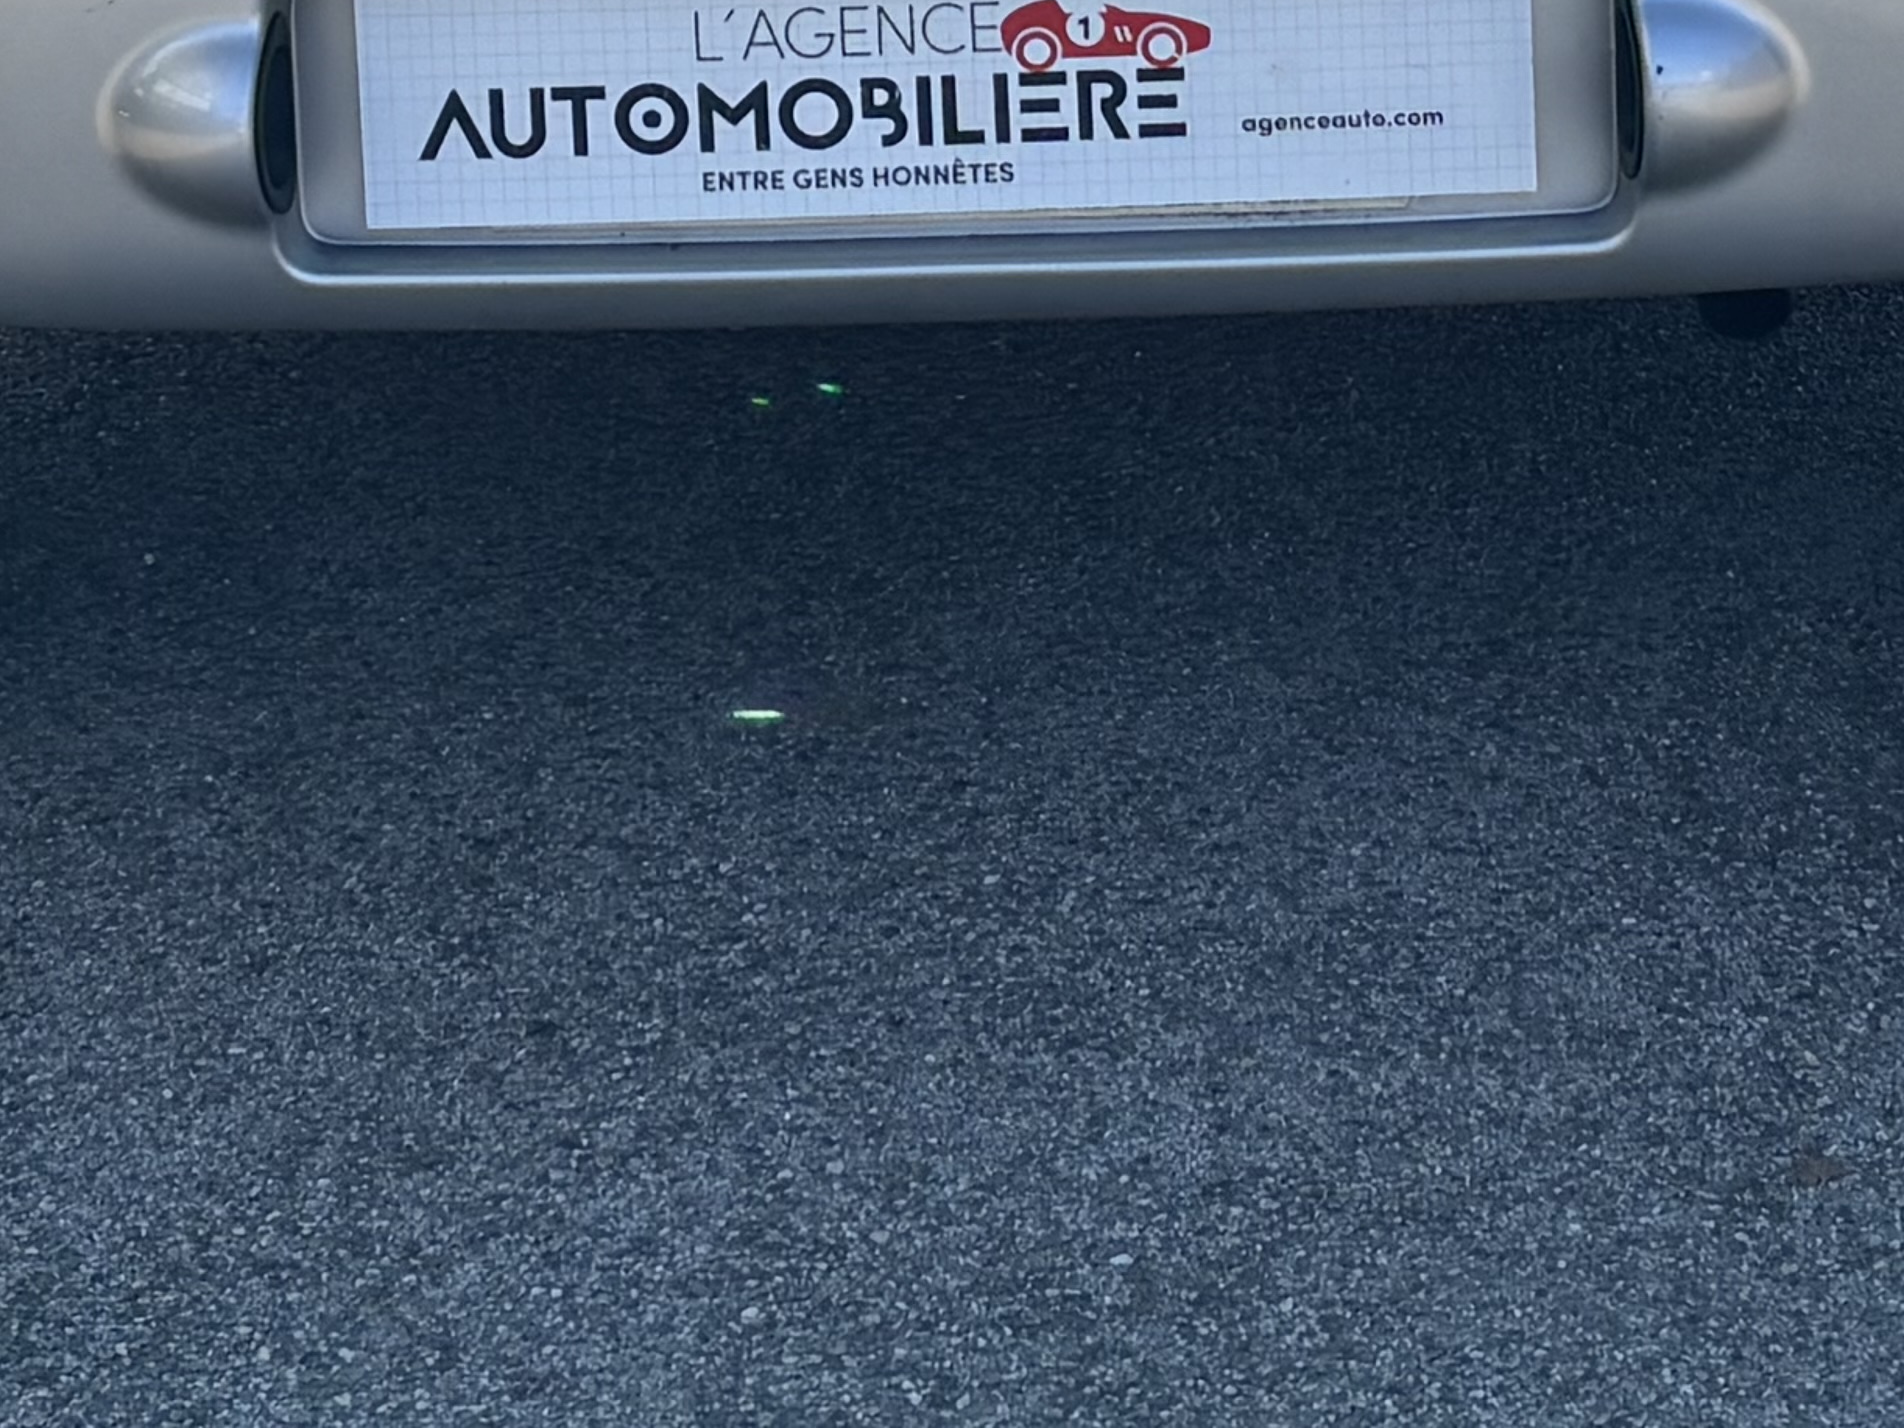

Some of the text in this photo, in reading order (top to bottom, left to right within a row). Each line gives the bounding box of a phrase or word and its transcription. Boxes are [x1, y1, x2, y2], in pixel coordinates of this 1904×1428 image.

[693, 0, 1002, 62] L'AGENCE
[1241, 107, 1445, 134] agenceauto.com
[702, 156, 1015, 193] ENTRE GENS HONNÊTES
